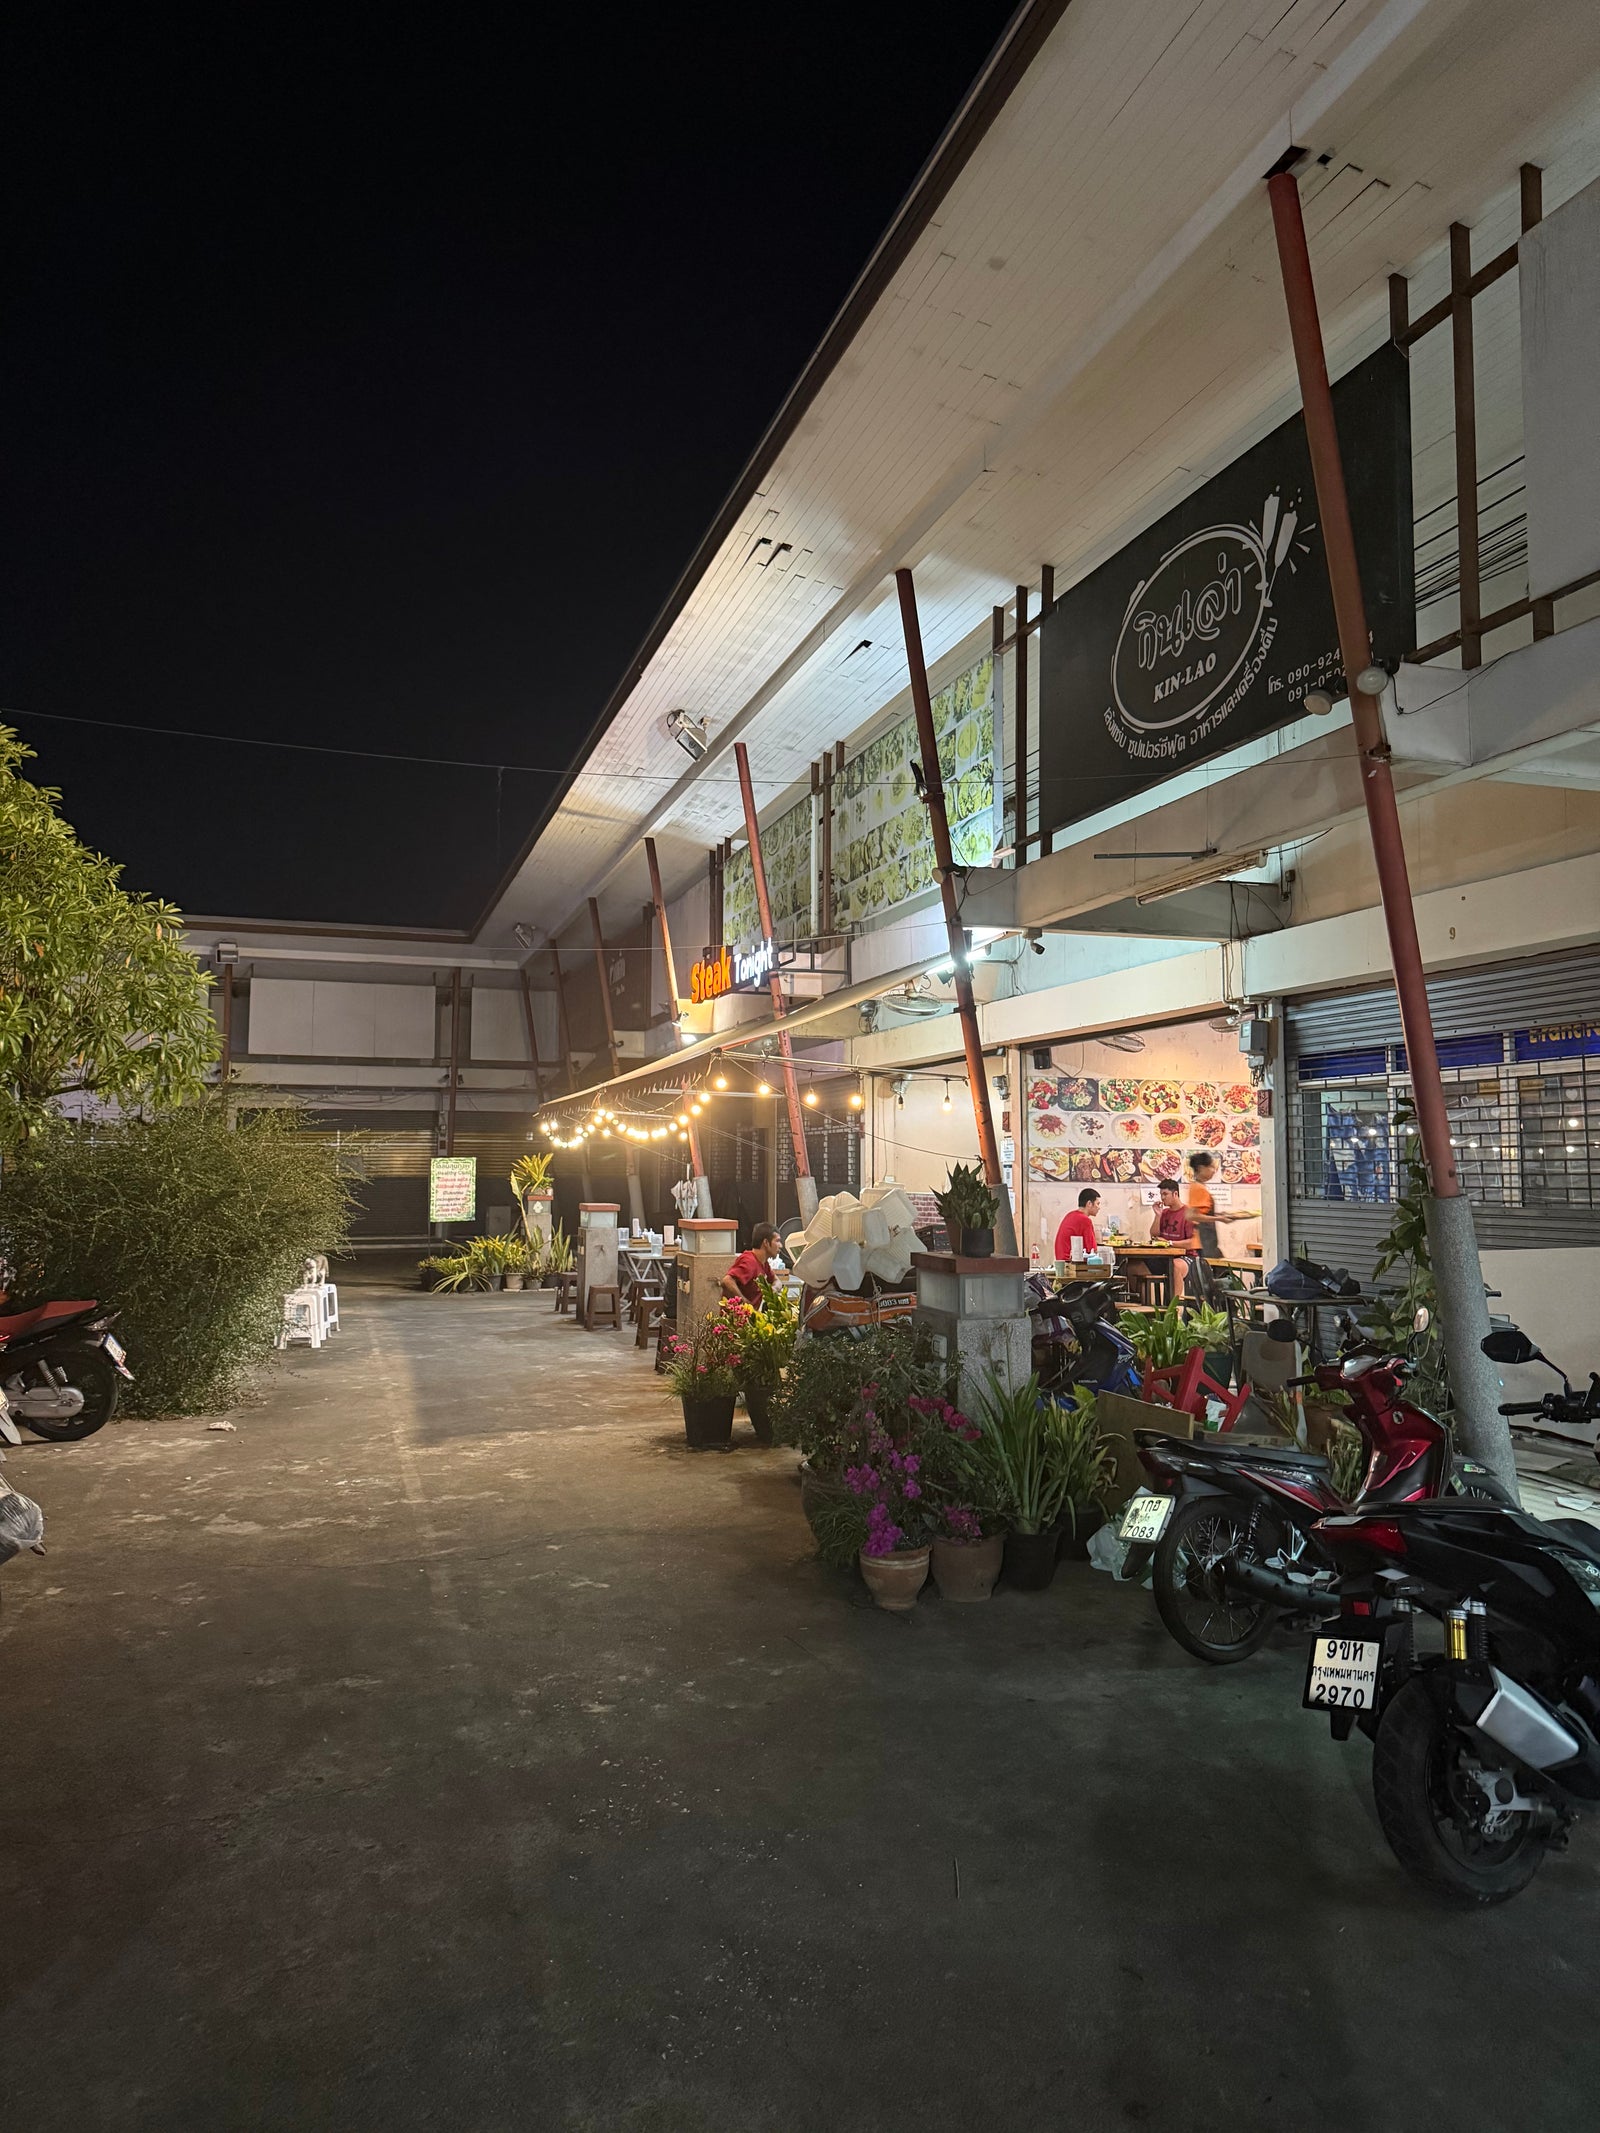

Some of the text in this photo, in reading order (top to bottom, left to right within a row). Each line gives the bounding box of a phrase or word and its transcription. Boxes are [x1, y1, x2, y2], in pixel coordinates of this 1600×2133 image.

[1153, 652, 1217, 704] KIN-LAO
[691, 946, 732, 1004] Steak
[734, 937, 773, 988] Tonight
[1124, 1525, 1155, 1539] 7083
[1312, 1665, 1375, 1682] กรุงเทพมหานคร
[1314, 1683, 1365, 1708] 2970
